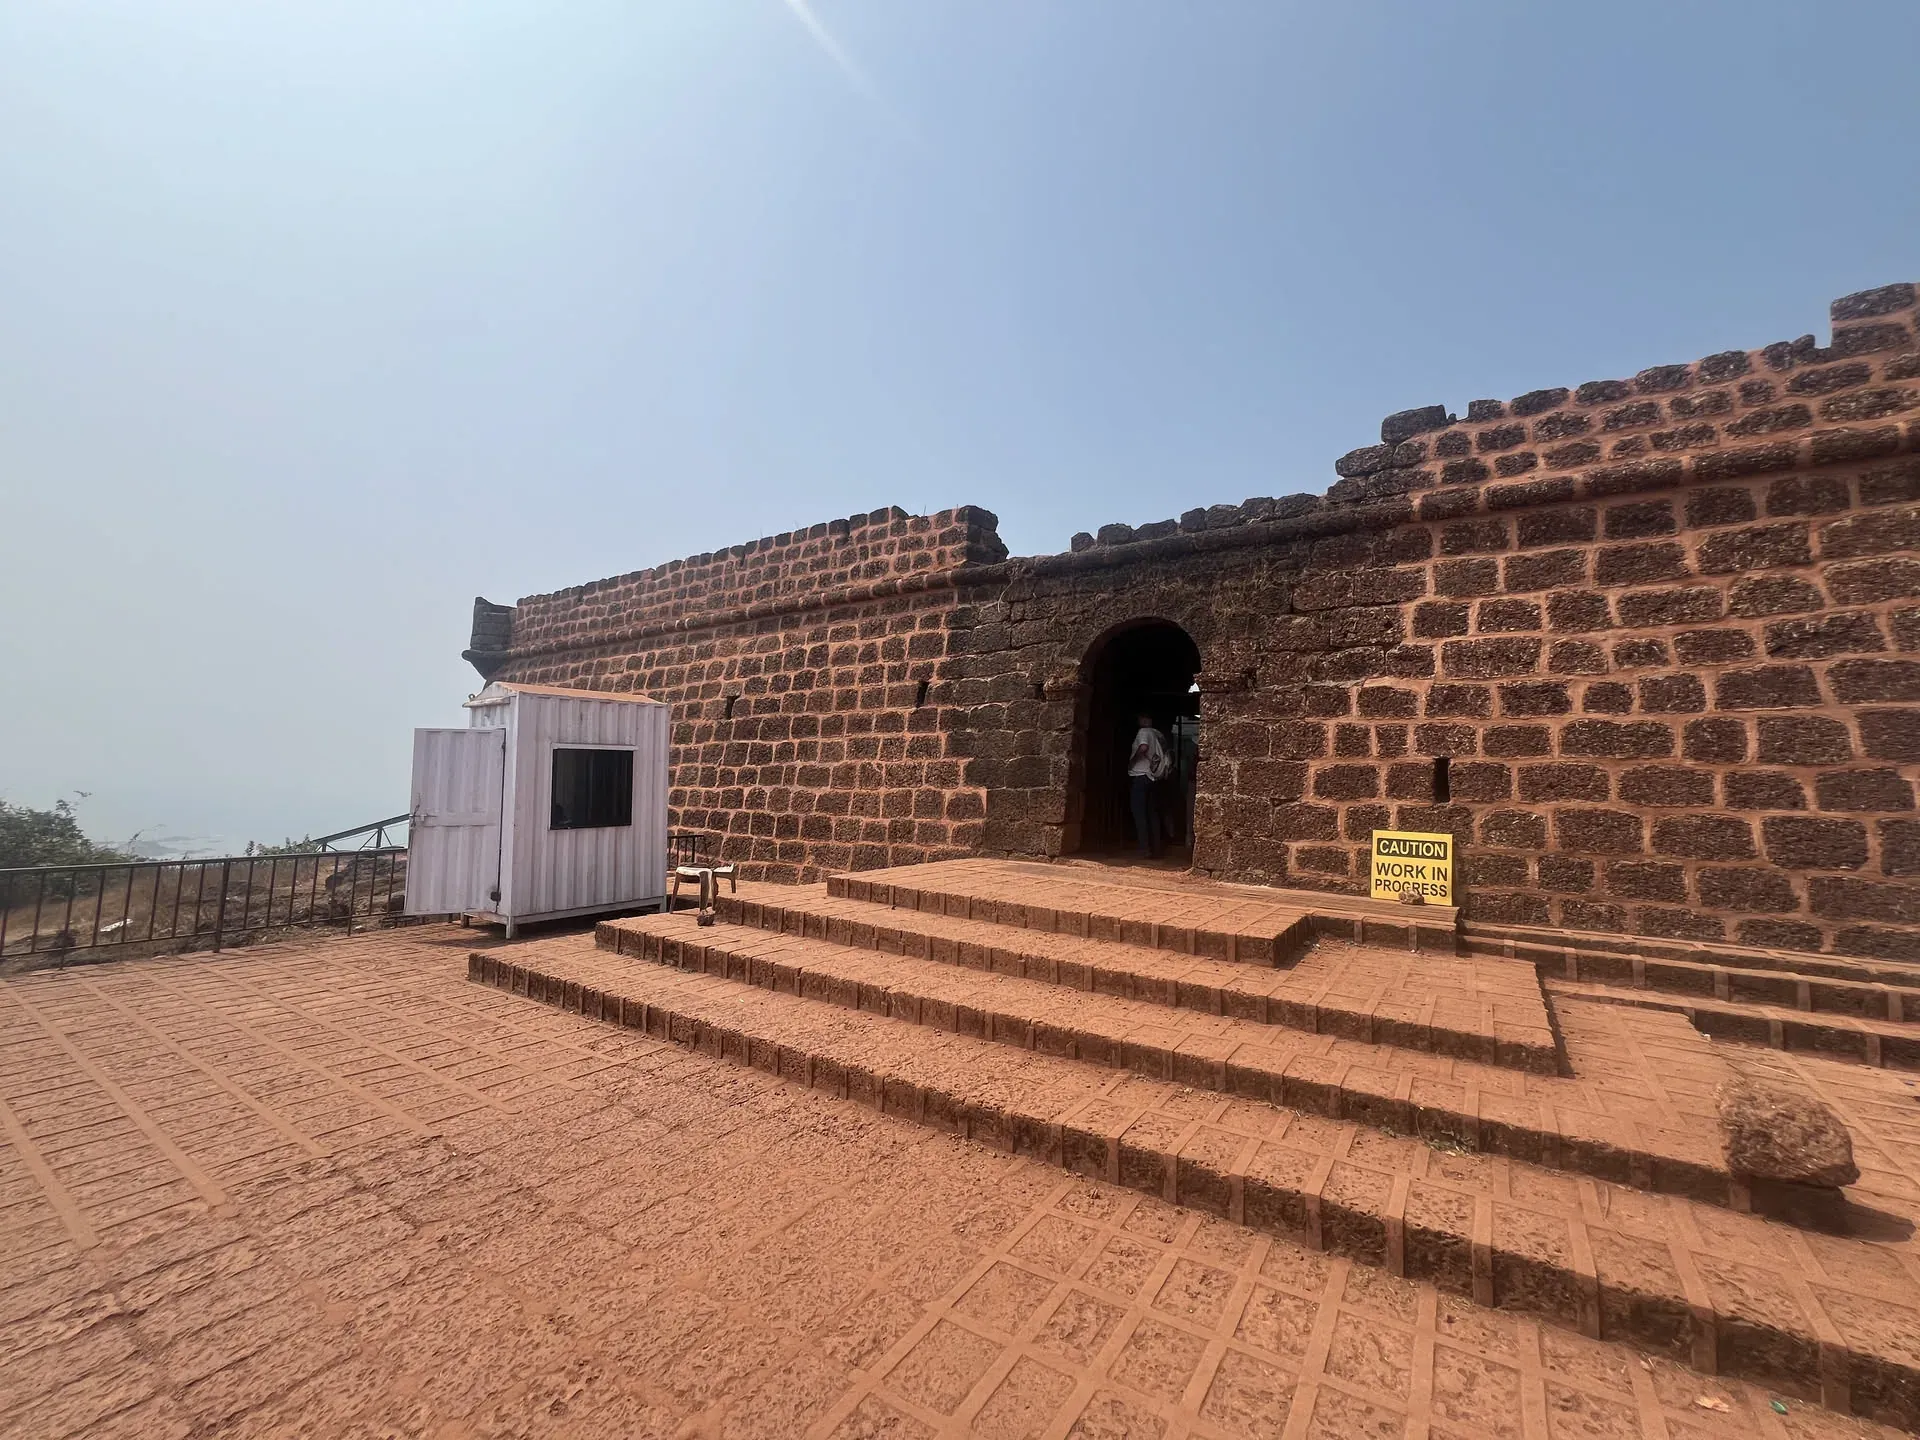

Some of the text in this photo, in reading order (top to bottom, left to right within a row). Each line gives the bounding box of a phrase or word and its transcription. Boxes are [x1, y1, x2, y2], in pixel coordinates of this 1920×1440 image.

[1380, 840, 1444, 857] CAUTION
[1376, 862, 1448, 881] WORK IN
[1375, 878, 1447, 898] PROGRESS
